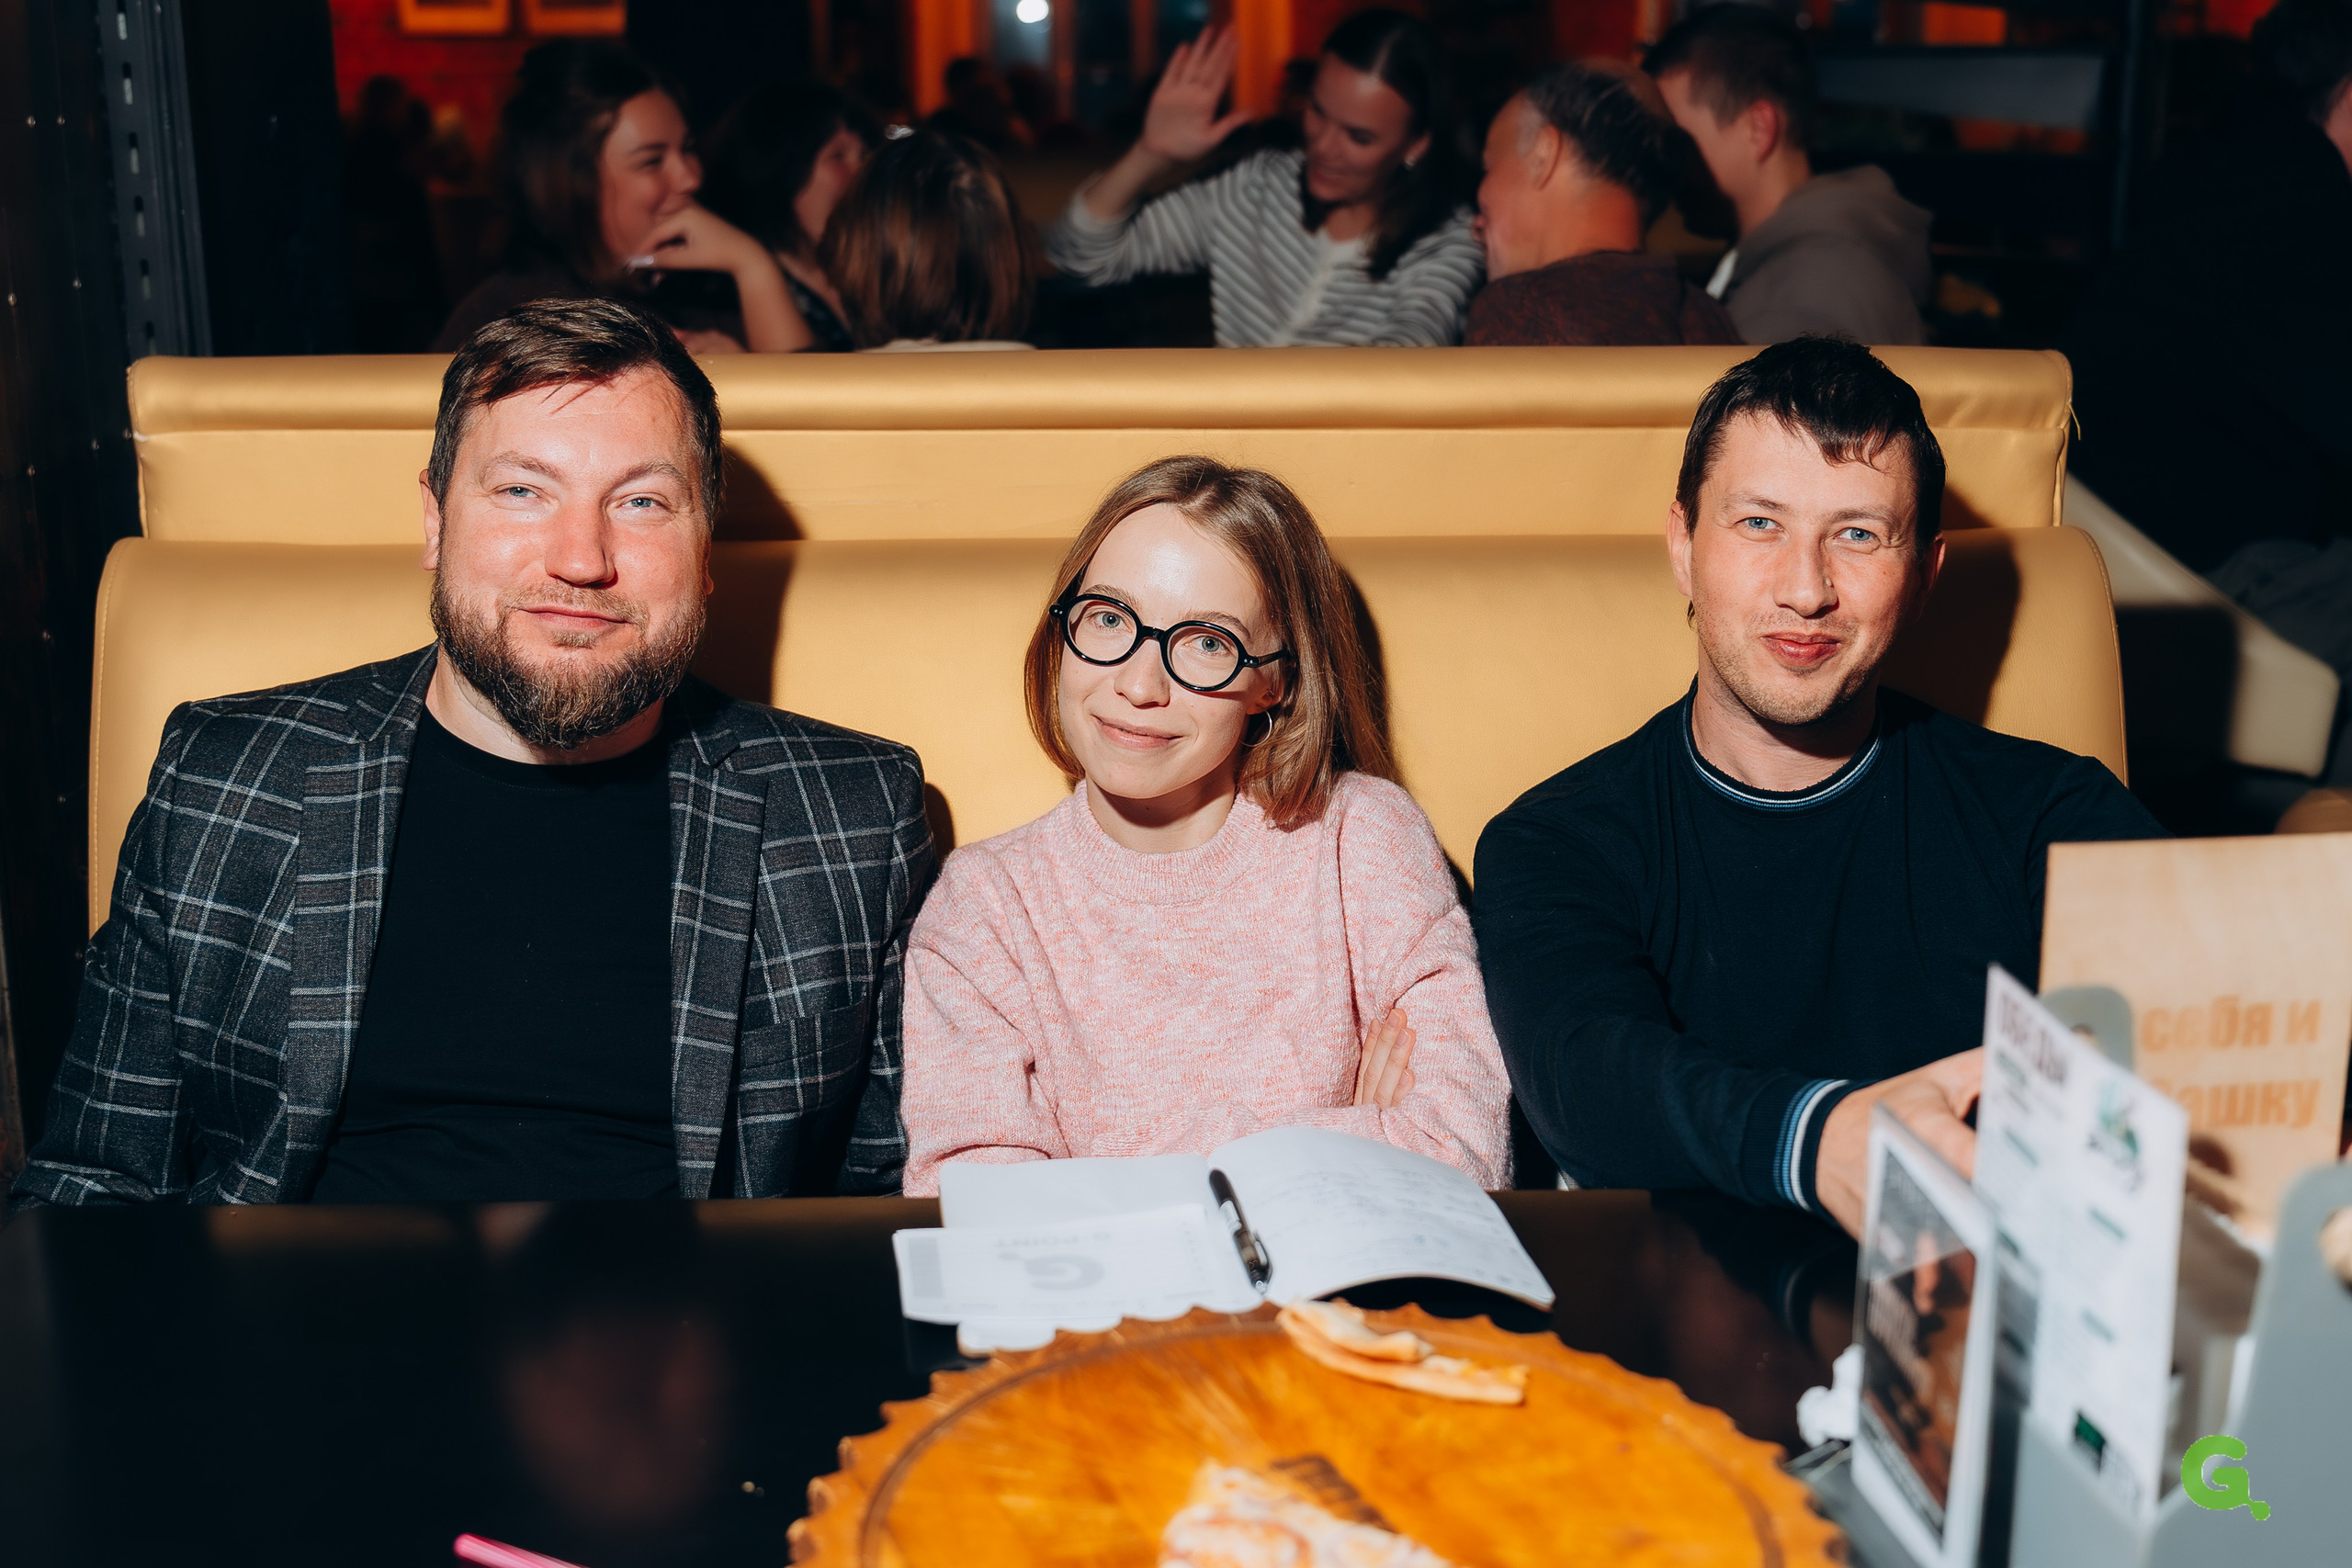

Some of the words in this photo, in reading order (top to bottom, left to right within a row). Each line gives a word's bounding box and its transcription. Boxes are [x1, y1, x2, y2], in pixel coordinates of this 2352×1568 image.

[2143, 995, 2274, 1052] себя
[2286, 998, 2321, 1044] и
[2151, 1077, 2322, 1129] ашку
